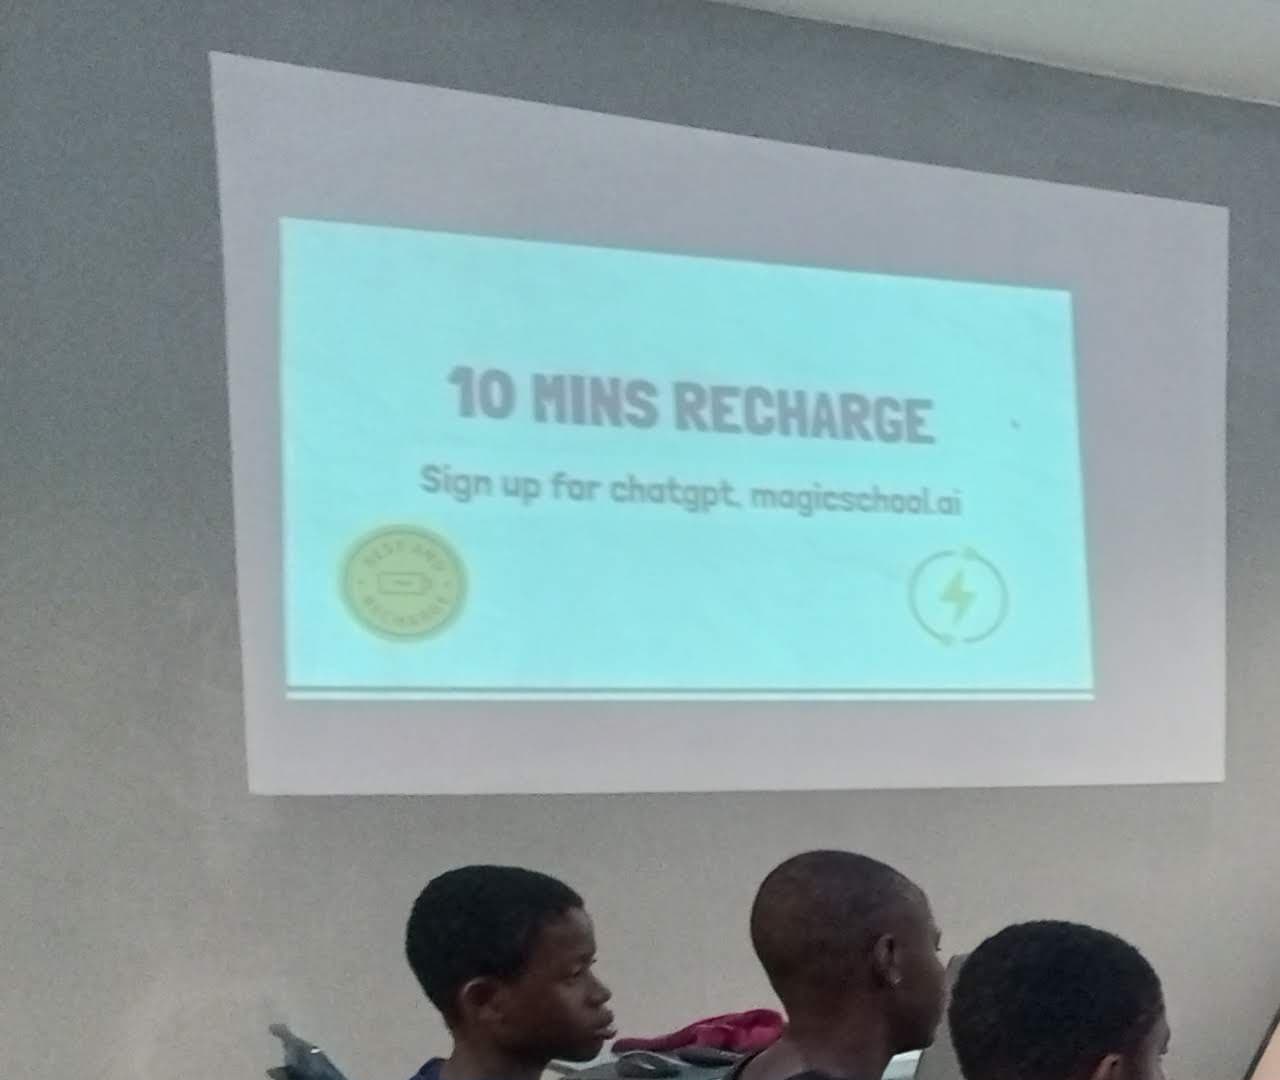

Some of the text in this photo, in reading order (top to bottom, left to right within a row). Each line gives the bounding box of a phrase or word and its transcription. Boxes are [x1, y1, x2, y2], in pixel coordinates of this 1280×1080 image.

[447, 364, 936, 445] 10 MINS RECHARGE
[419, 462, 493, 503] Sign
[502, 475, 542, 507] up
[551, 471, 602, 502] for
[751, 481, 963, 518] magicschool.ai
